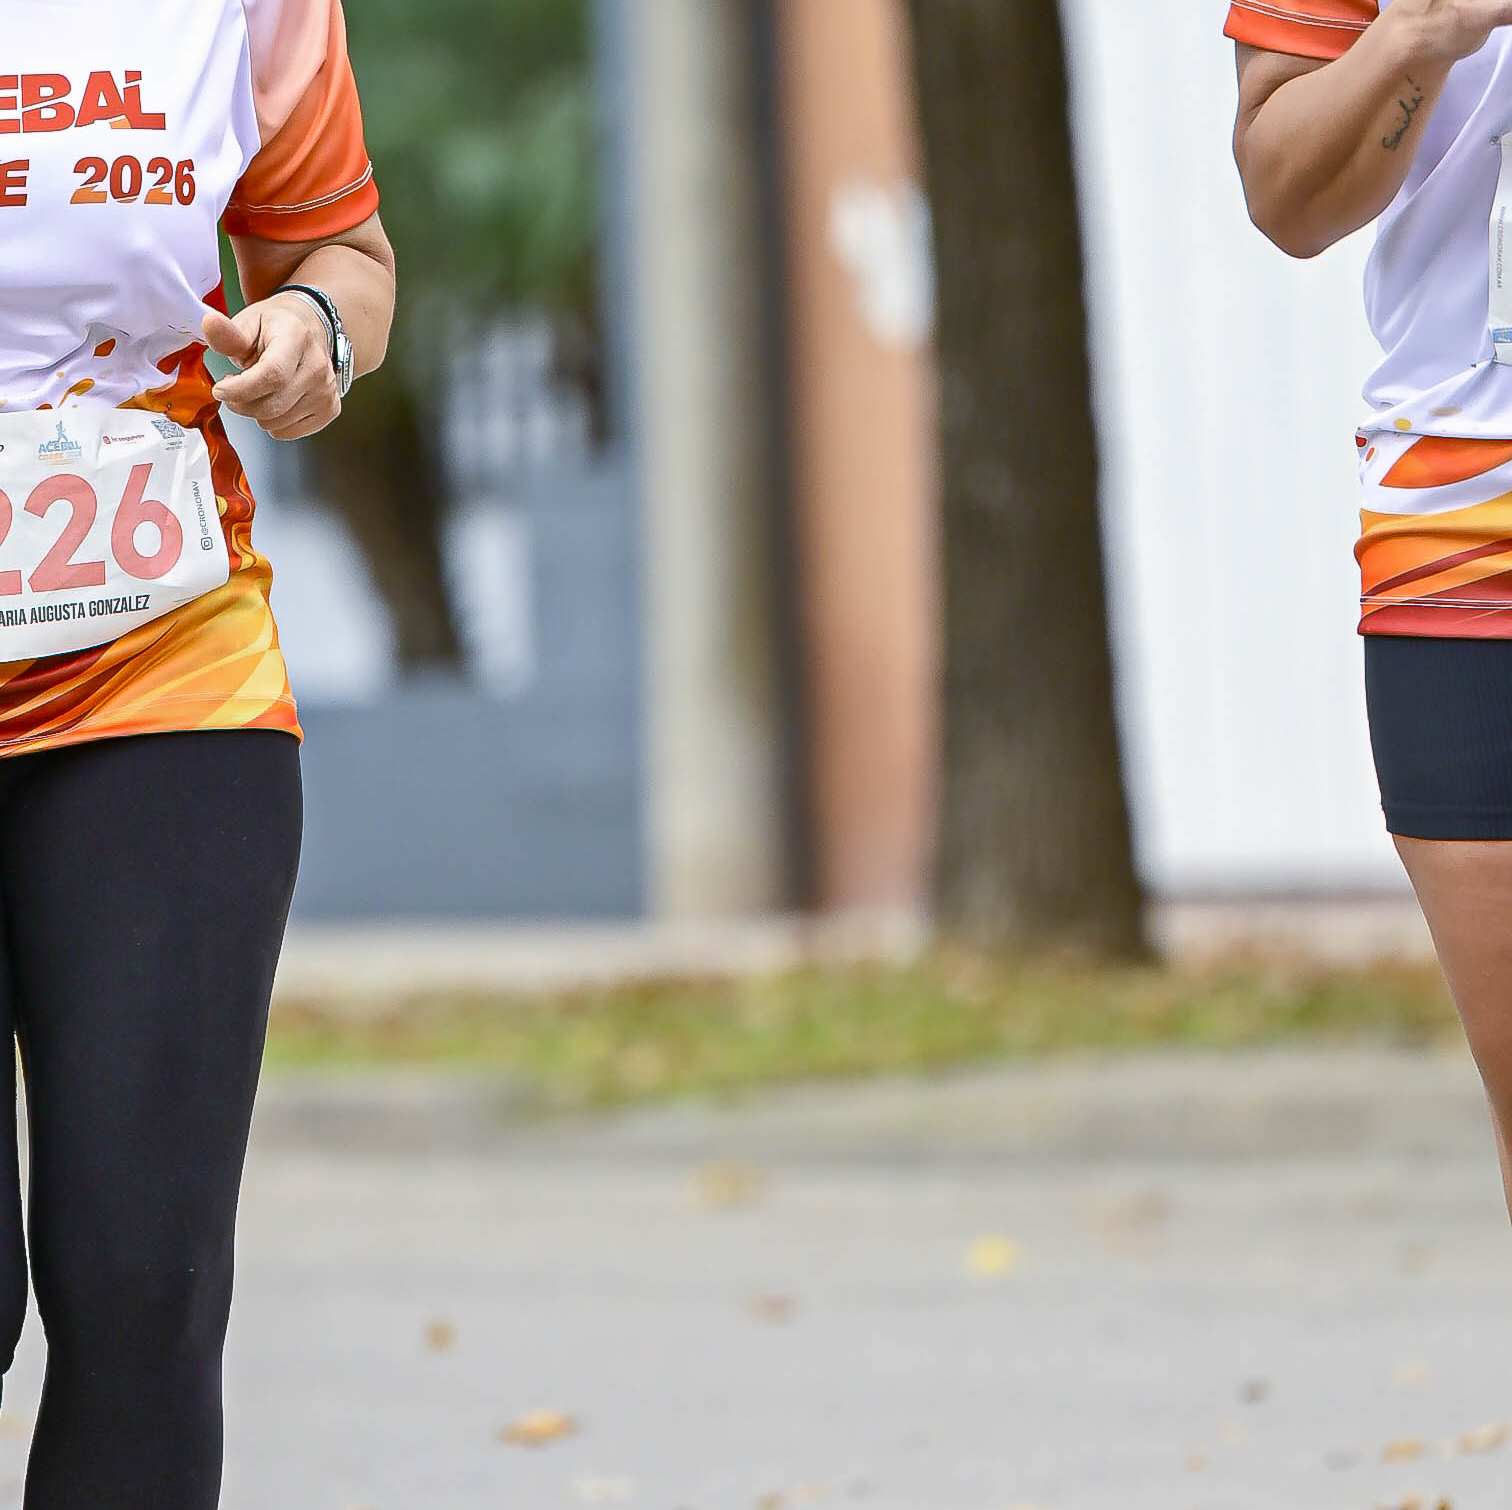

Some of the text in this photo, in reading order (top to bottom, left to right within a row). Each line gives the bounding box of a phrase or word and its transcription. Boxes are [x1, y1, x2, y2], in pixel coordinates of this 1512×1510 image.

[70, 155, 196, 206] 2026
[192, 480, 209, 535] @CRONORAV
[29, 602, 86, 625] AUGUSTA
[88, 594, 151, 617] GONZALEZ
